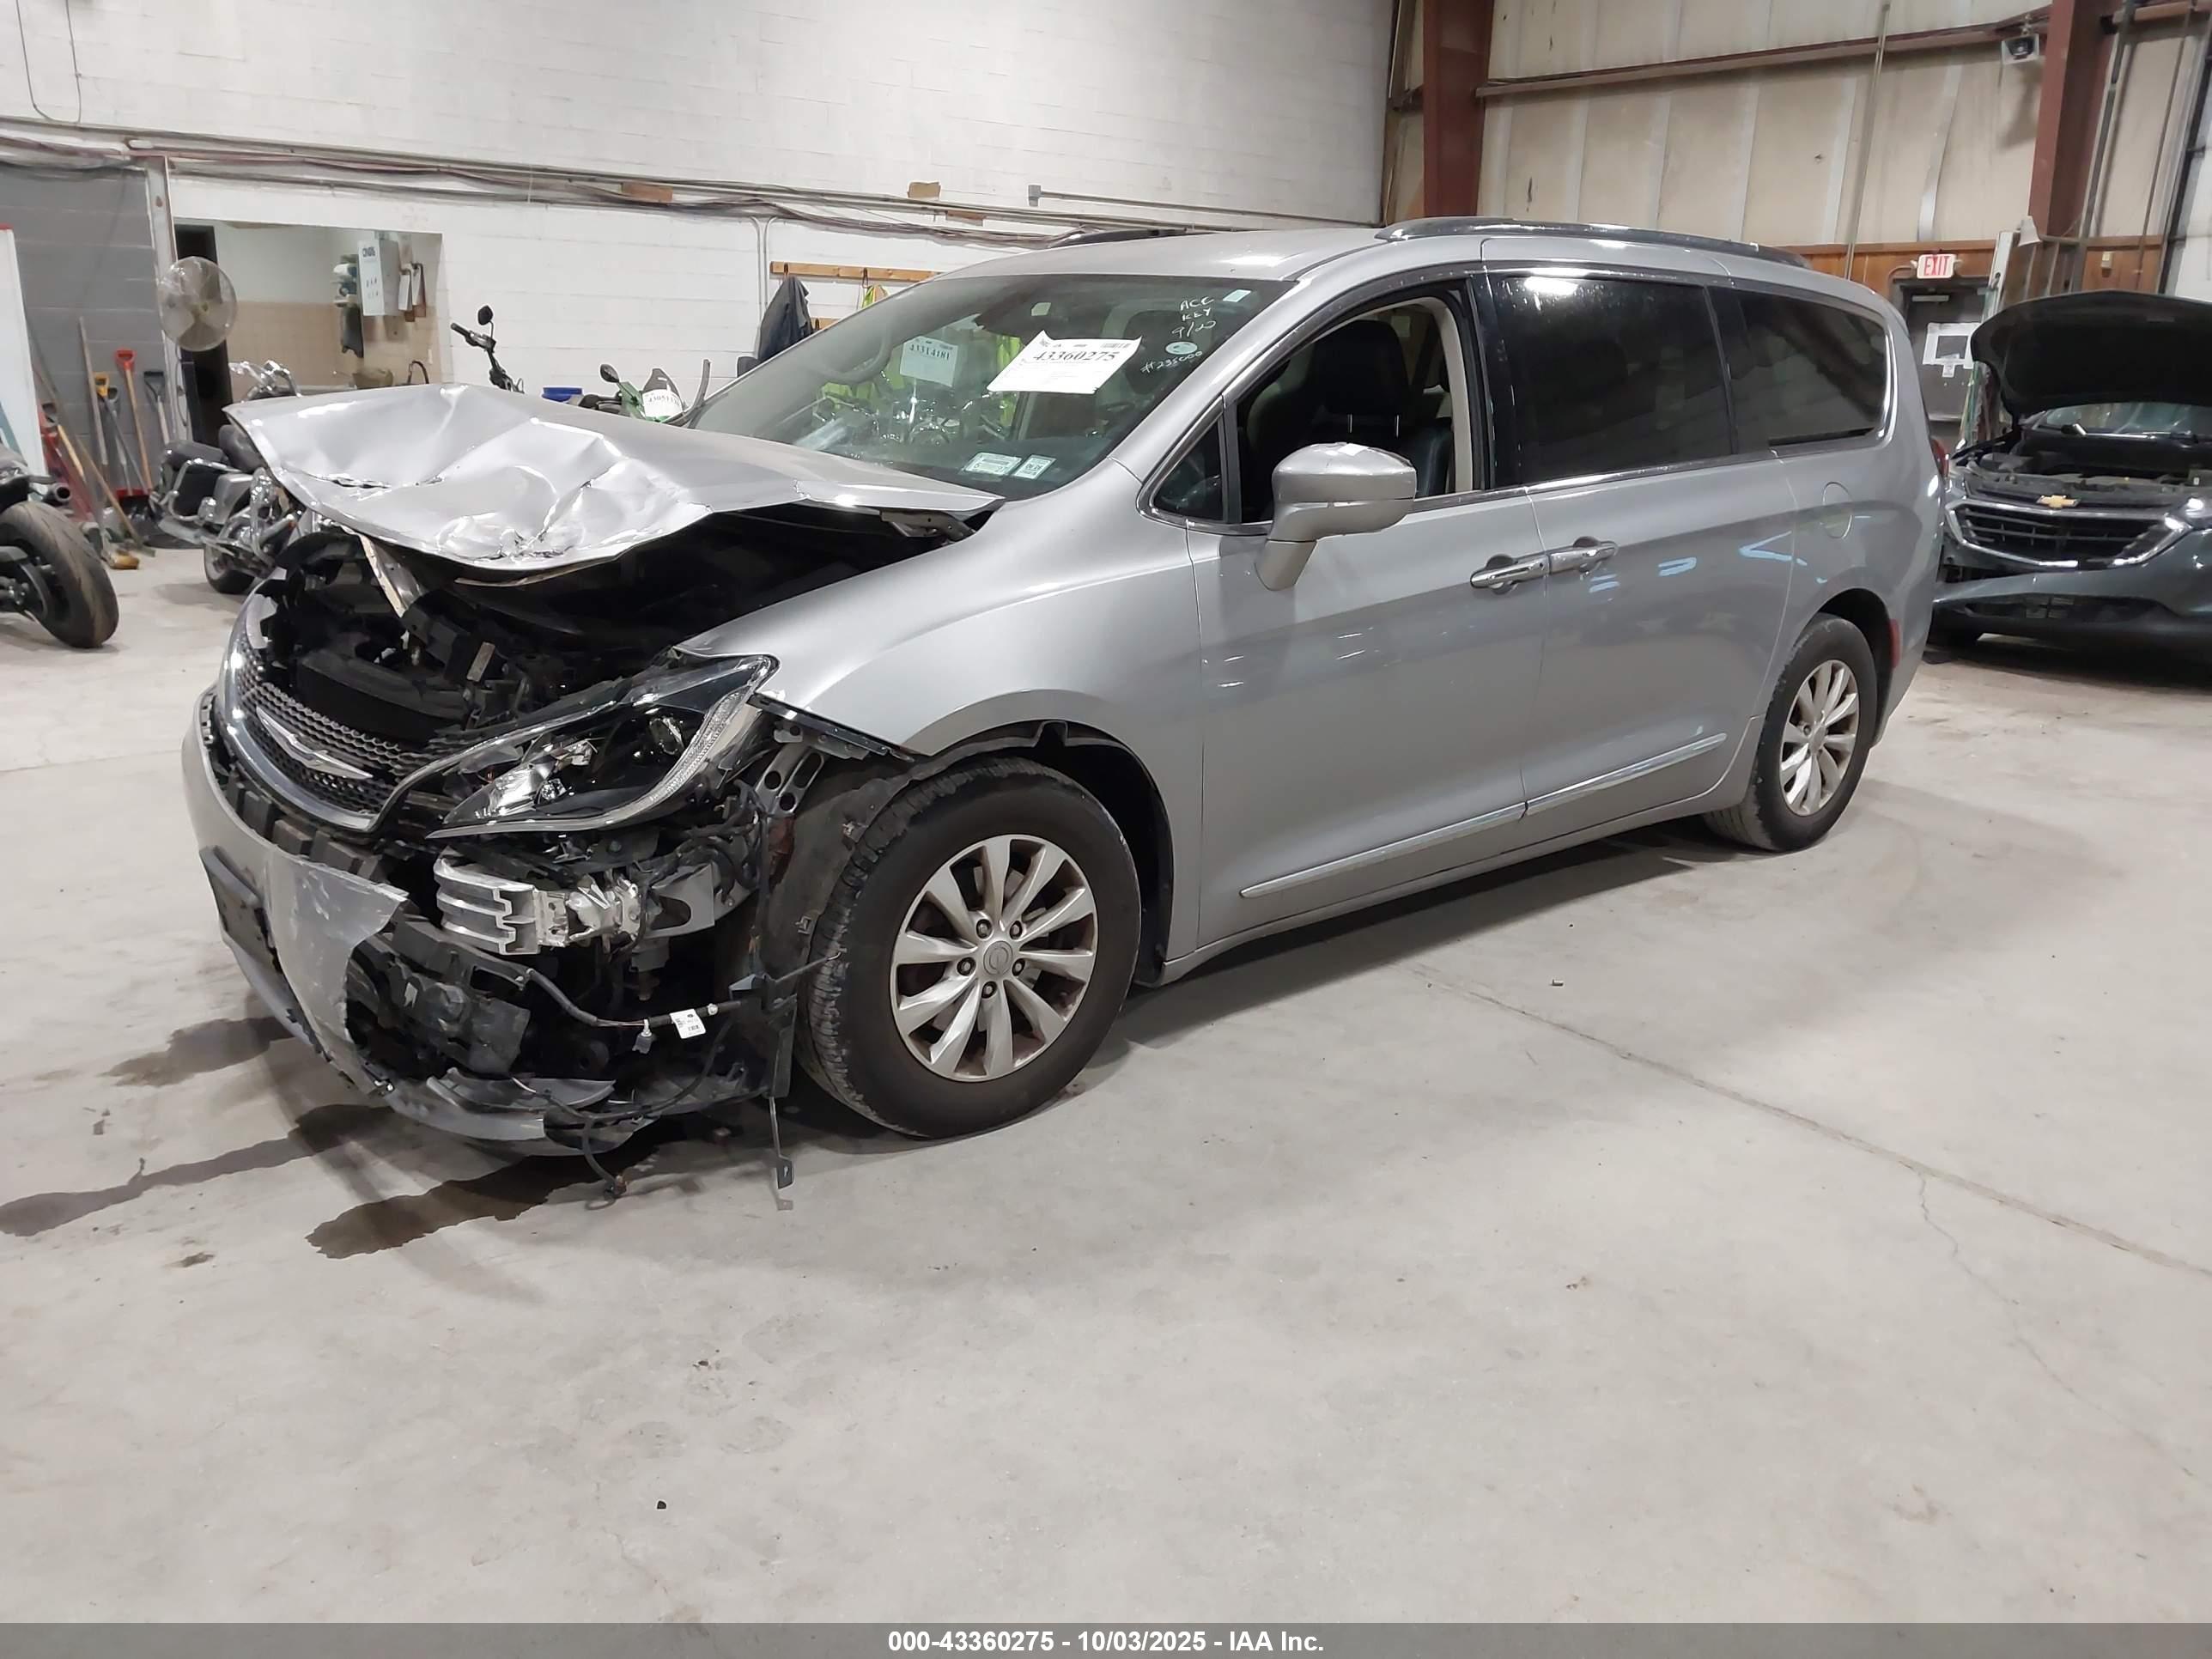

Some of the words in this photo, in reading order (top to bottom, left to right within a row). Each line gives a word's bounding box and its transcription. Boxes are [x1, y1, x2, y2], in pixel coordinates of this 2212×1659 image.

[1923, 256, 1950, 276] EXIT
[1180, 296, 1214, 311] ACC
[1182, 307, 1211, 321] KEY
[1033, 351, 1120, 361] 43360275
